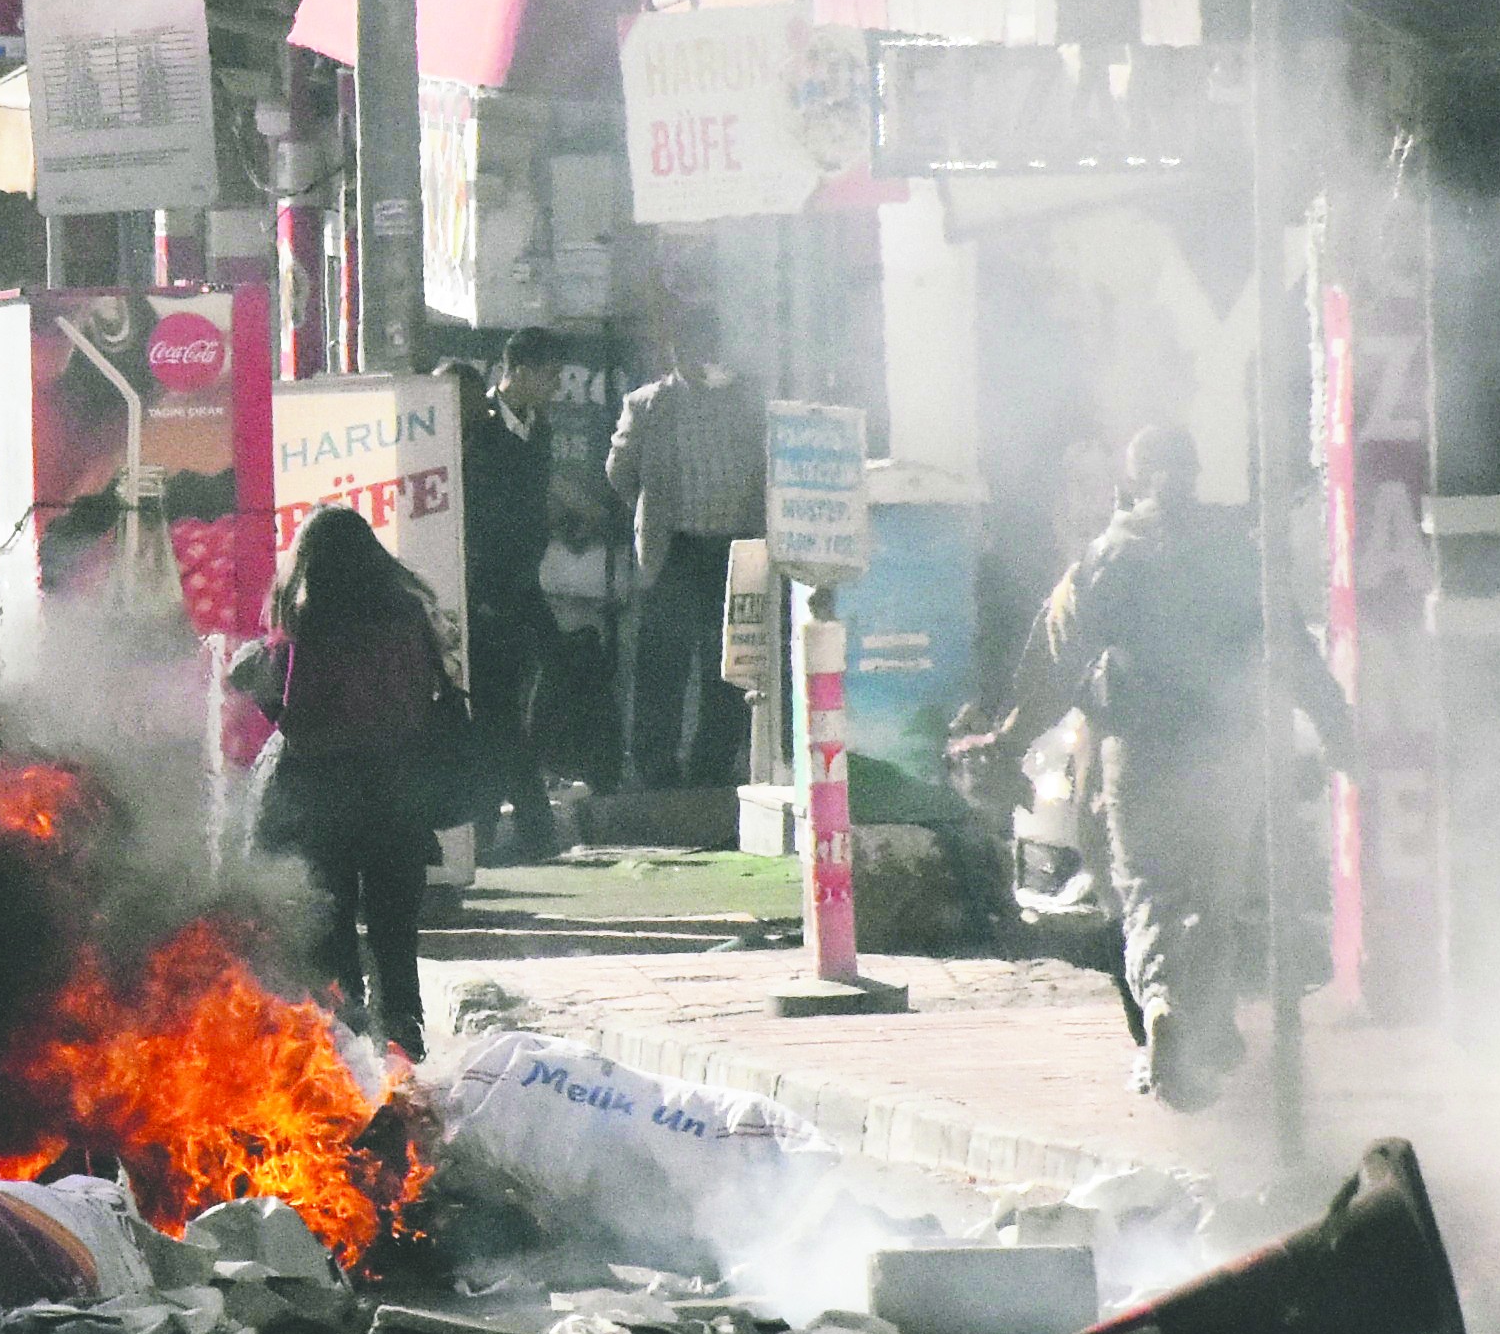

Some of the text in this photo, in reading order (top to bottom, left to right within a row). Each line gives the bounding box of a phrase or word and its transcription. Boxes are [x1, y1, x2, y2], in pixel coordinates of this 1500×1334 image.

[650, 109, 742, 177] BÜFE
[149, 339, 219, 364] Coca-Cola
[281, 405, 436, 472] HARUN
[521, 1060, 706, 1138] Melik Un
